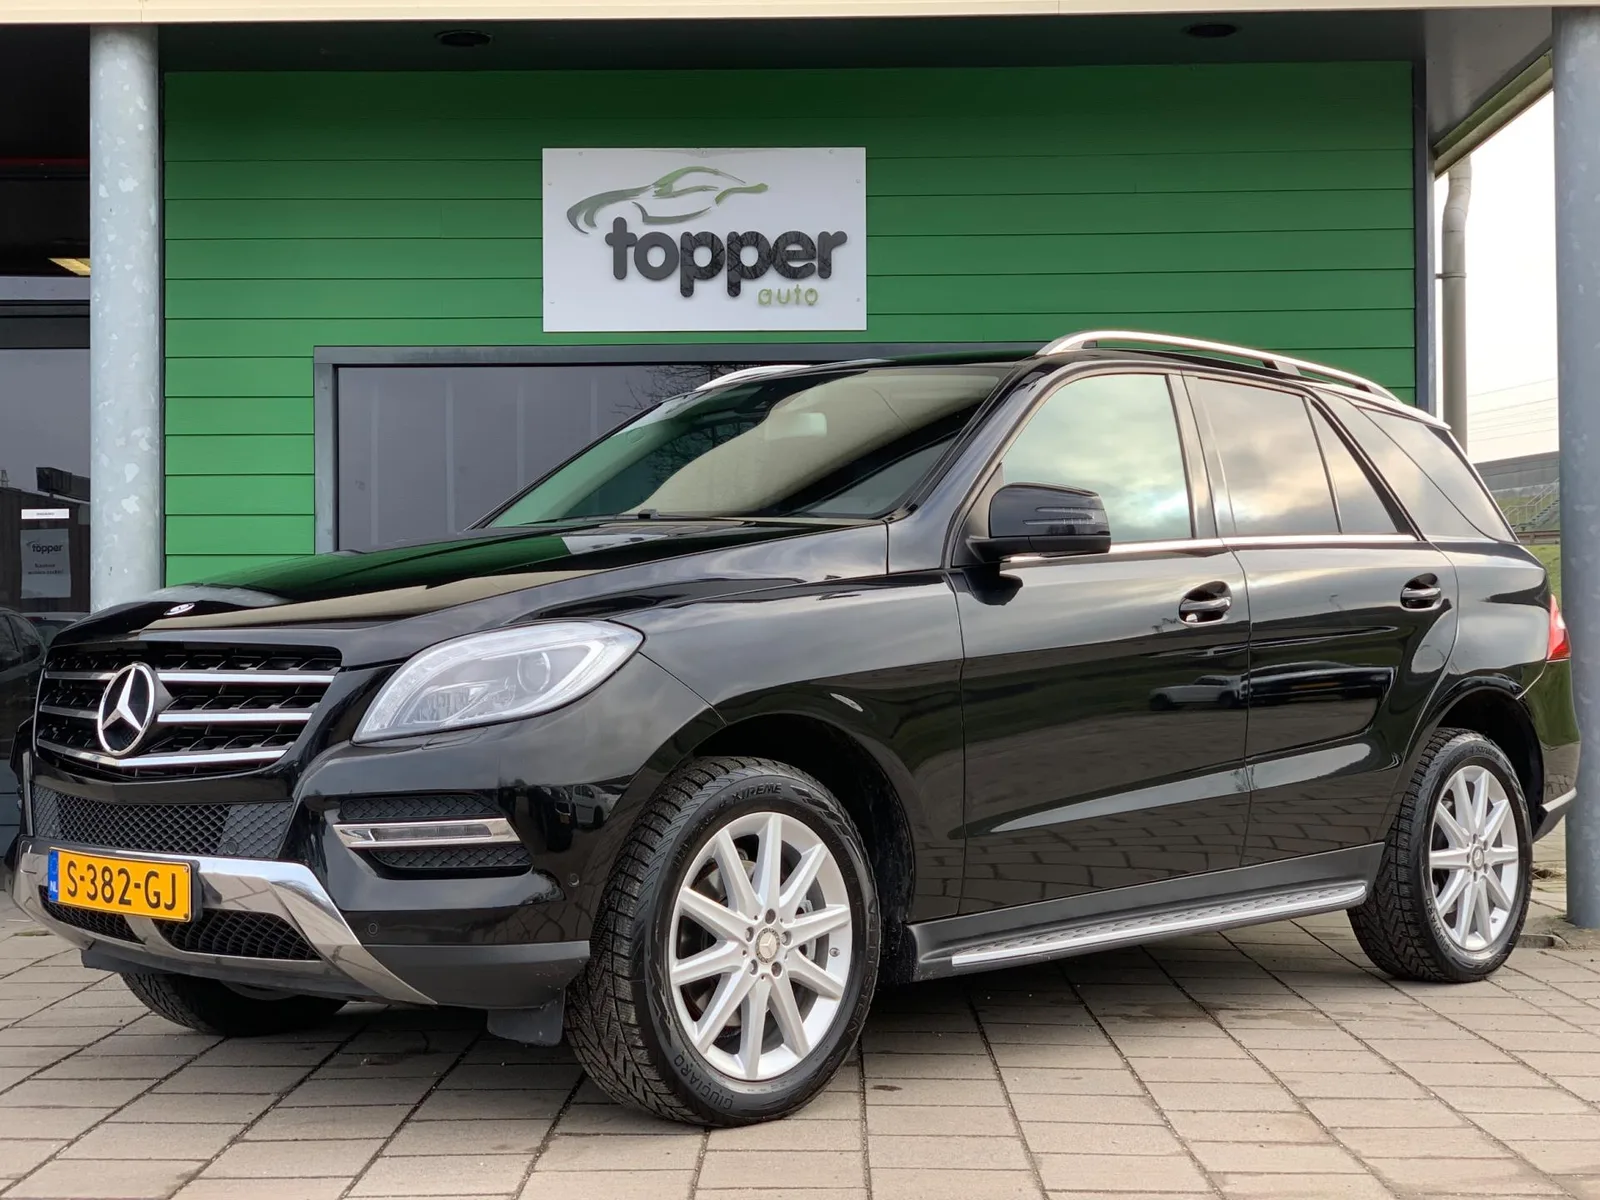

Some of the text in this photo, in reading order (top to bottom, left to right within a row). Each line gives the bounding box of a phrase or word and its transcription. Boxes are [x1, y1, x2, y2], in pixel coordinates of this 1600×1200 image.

[604, 216, 848, 298] topper
[758, 283, 819, 306] auto
[31, 543, 63, 555] topper
[49, 880, 58, 893] NL
[66, 860, 177, 911] S-382-GJ
[673, 1053, 734, 1110] GIUGIARO
